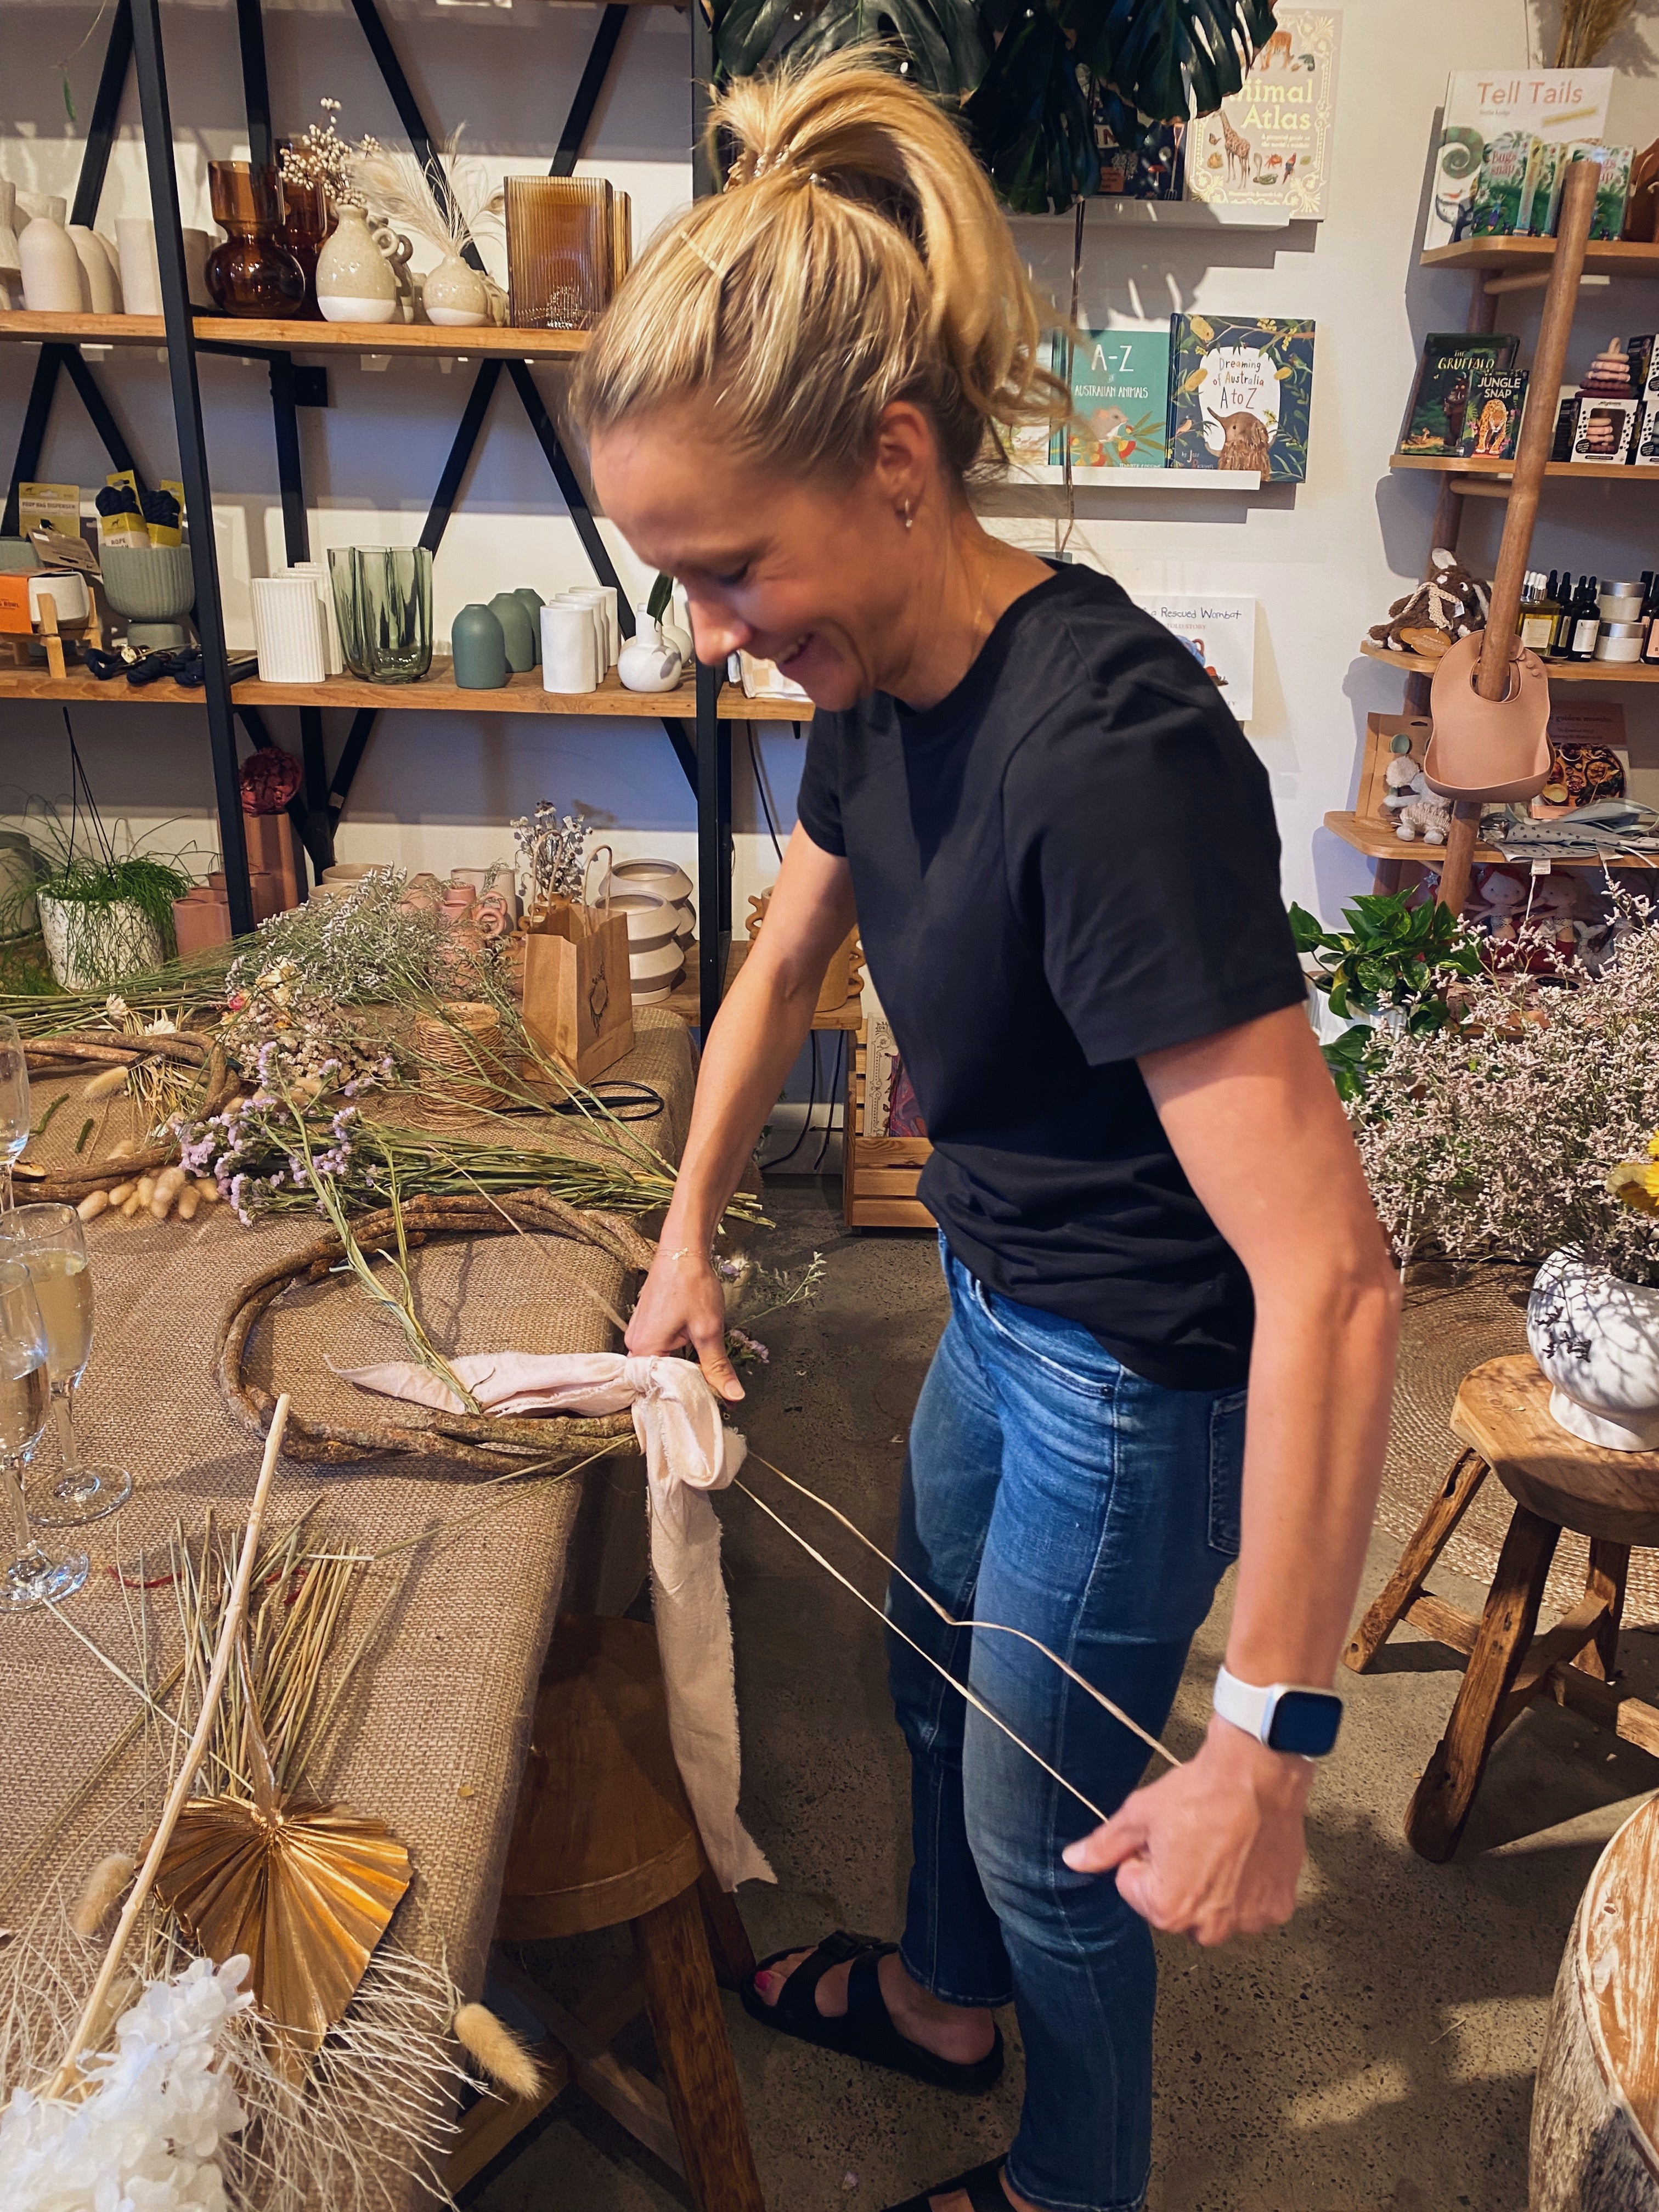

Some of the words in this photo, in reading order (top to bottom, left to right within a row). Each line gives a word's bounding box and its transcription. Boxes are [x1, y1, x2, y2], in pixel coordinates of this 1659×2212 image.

[1229, 78, 1313, 103] nimal
[1477, 81, 1521, 104] Tell
[1528, 80, 1583, 104] Tails
[1240, 104, 1311, 129] Atlas
[1492, 151, 1517, 164] Bugs
[1091, 344, 1134, 372] A-Z
[1220, 358, 1261, 373] Dreaming
[1438, 357, 1494, 370] GRUFFALO
[1213, 373, 1221, 386] of
[1225, 371, 1264, 386] Australia
[1478, 377, 1521, 388] JUNGLE
[1075, 385, 1116, 397] AUSTRALIAN
[1118, 386, 1148, 398] ANIMALS
[1220, 386, 1228, 409] A
[1232, 388, 1243, 404] to
[1246, 387, 1257, 409] Z
[1484, 388, 1512, 398] SNAP
[1161, 607, 1196, 618] Rescued
[1201, 607, 1242, 619] Wombat
